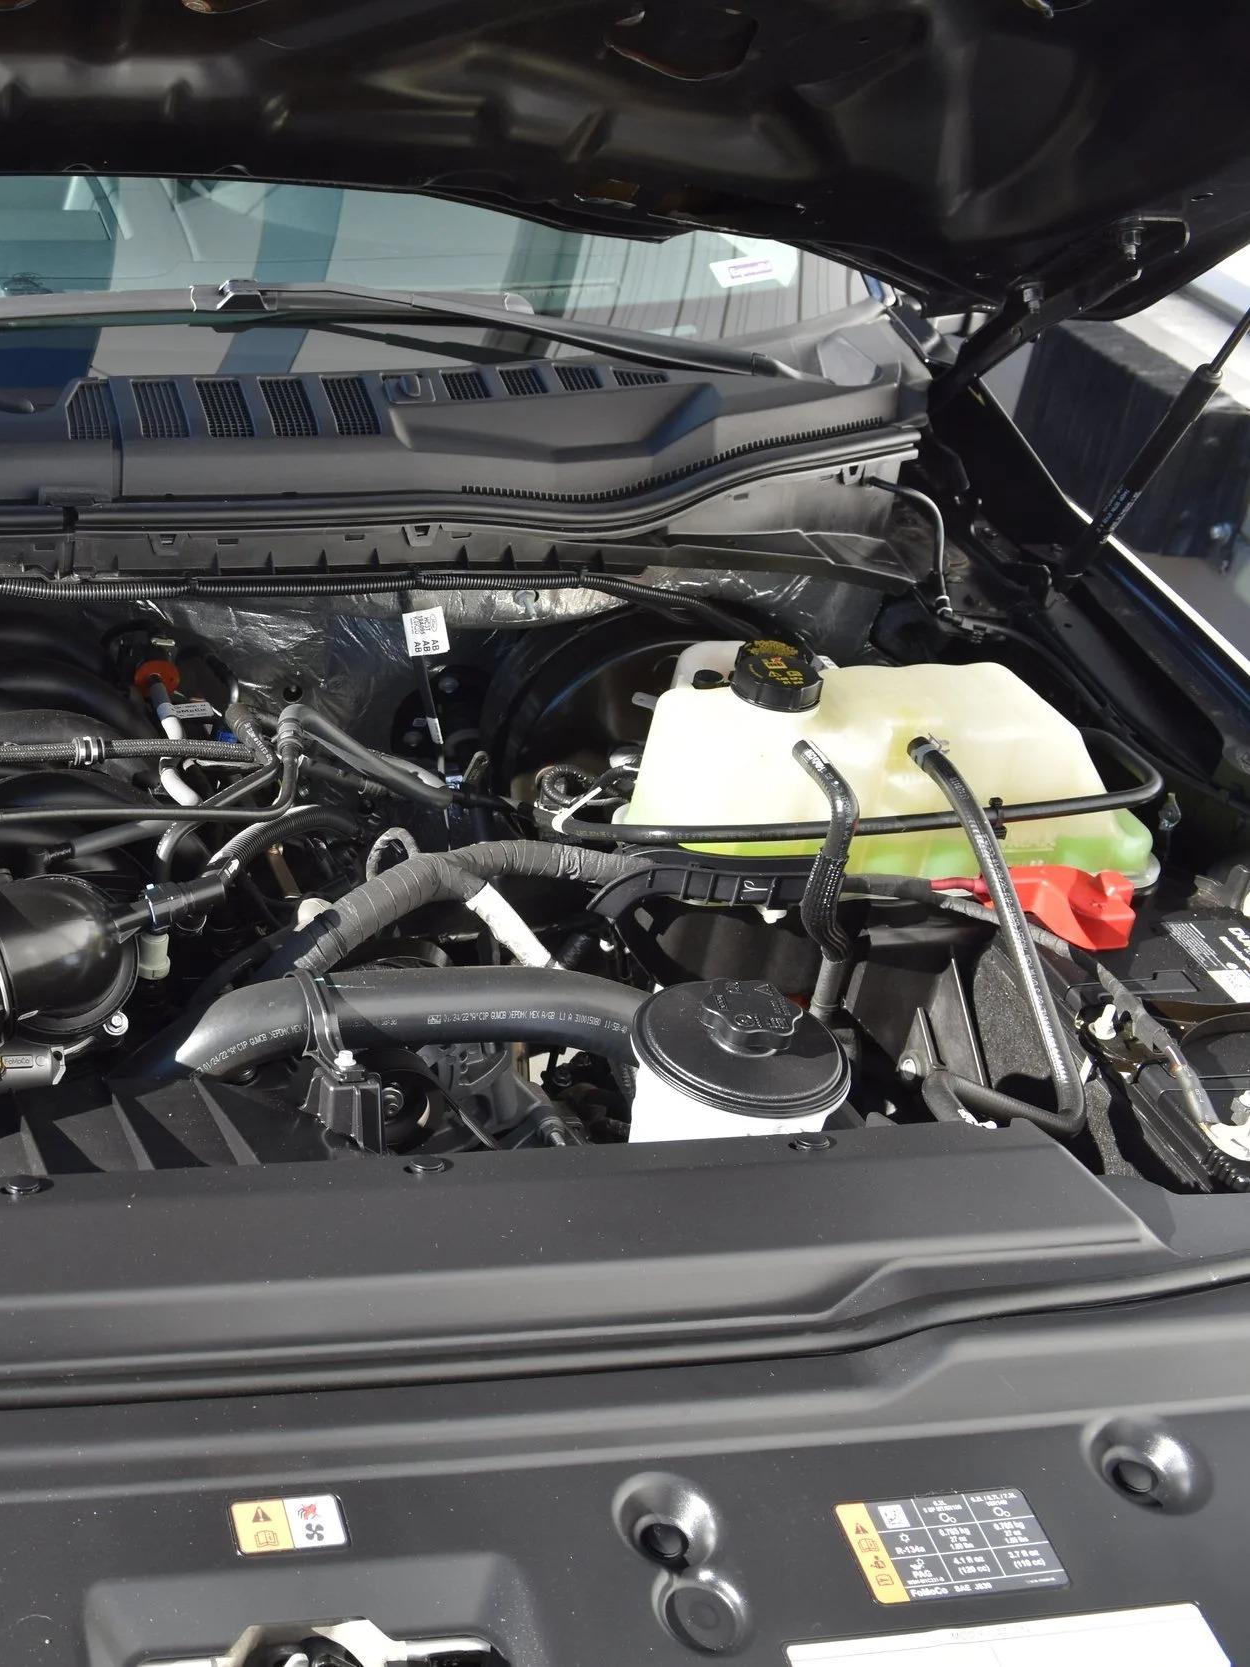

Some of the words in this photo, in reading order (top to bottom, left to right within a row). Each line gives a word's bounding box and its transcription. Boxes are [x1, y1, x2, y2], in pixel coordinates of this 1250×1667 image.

[414, 641, 422, 653] AB
[423, 640, 431, 651] AB
[431, 640, 439, 651] AB
[894, 1545, 926, 1555] R-134a
[912, 1569, 933, 1579] PAG
[910, 1586, 949, 1598] FoMoCo
[953, 1584, 972, 1592] SAE
